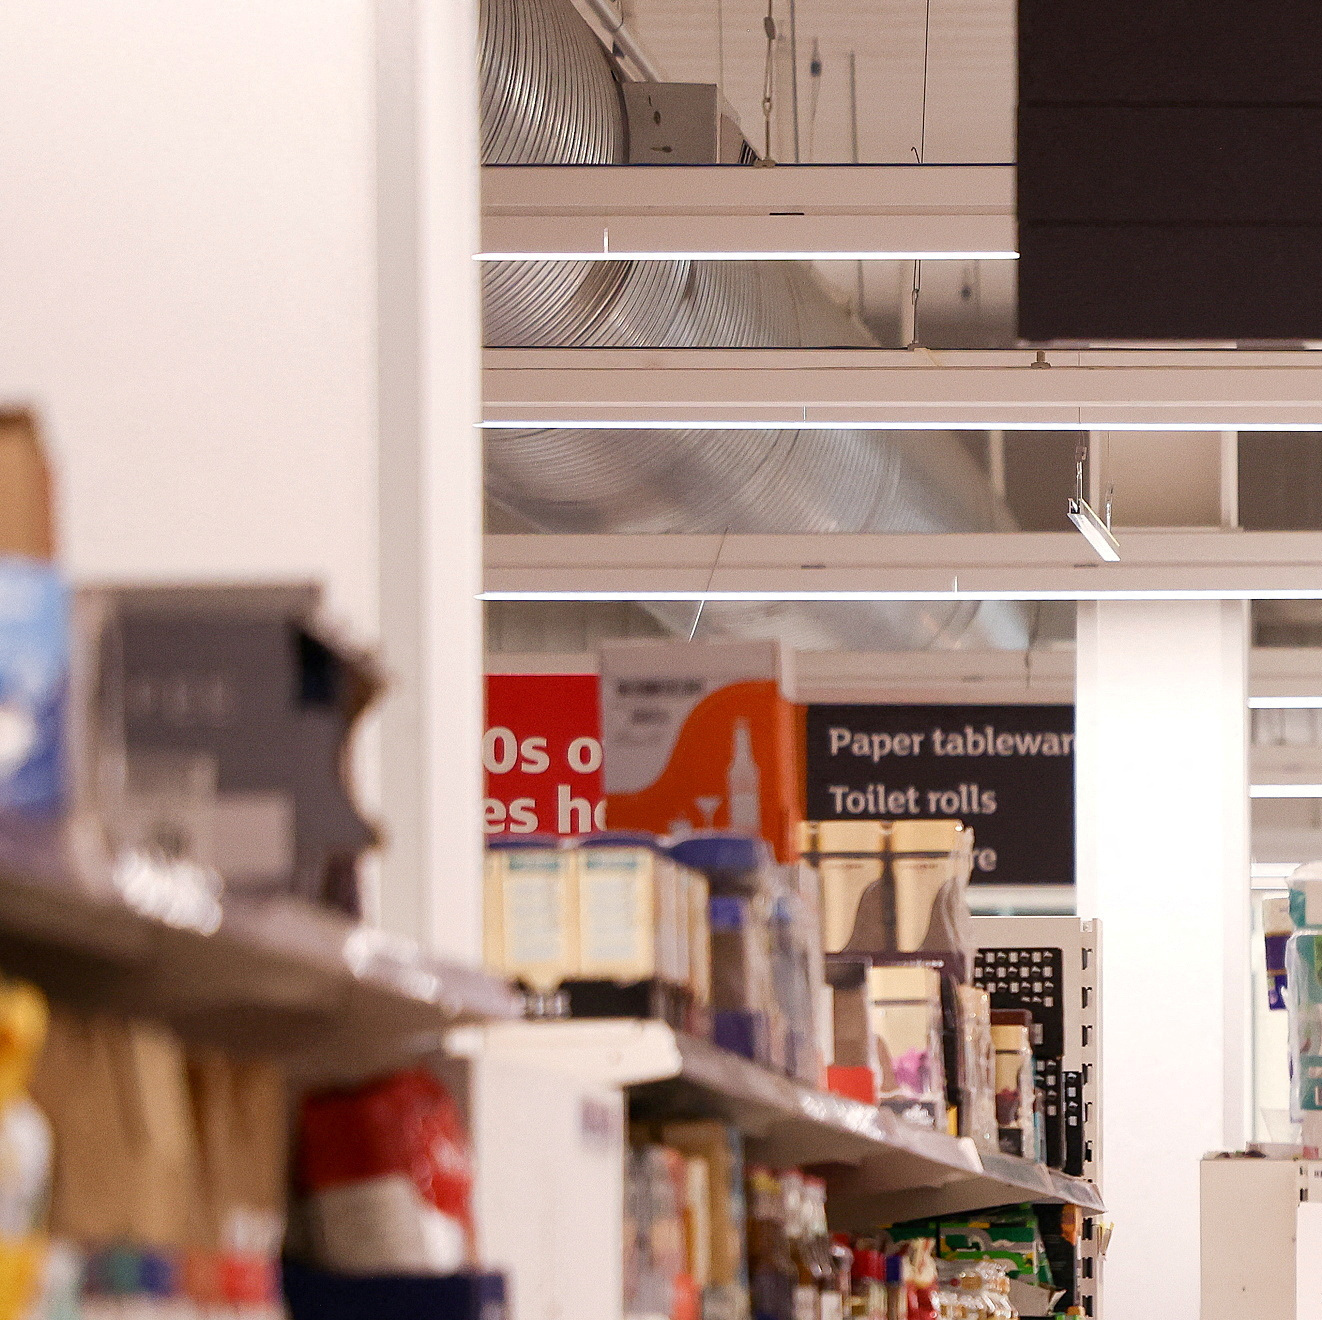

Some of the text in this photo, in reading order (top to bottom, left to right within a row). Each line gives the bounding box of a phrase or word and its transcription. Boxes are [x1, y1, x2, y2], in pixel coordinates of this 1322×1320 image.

[829, 726, 1078, 763] Paper tablewar
[828, 784, 997, 815] Toilet rolls
